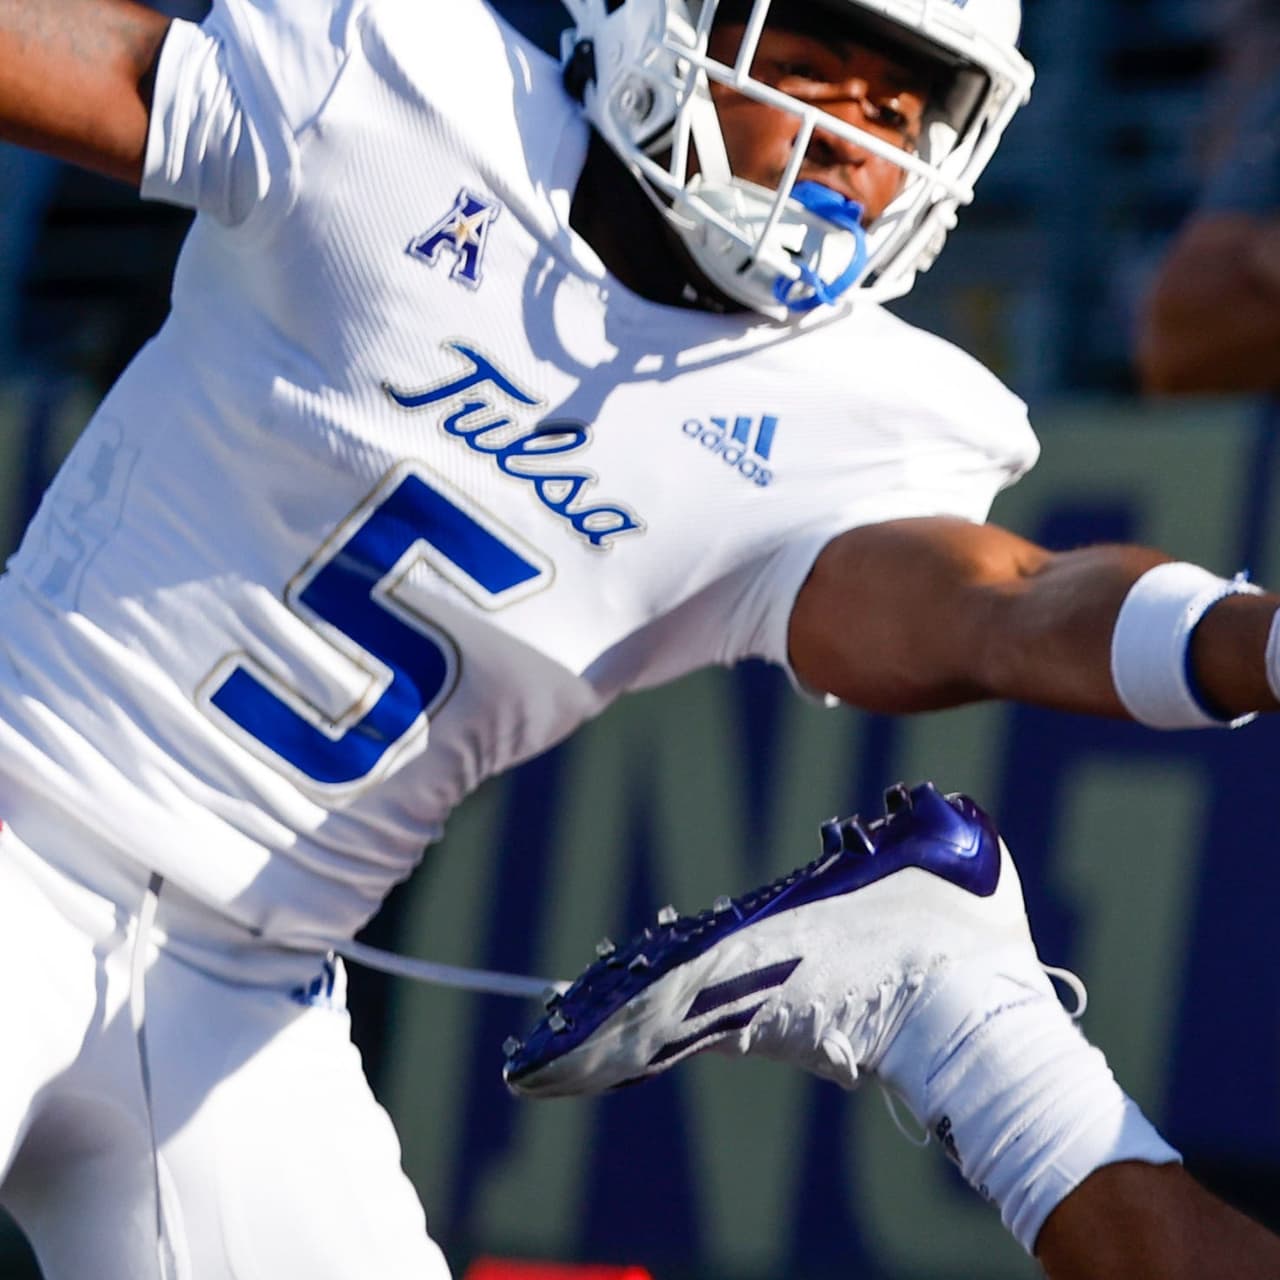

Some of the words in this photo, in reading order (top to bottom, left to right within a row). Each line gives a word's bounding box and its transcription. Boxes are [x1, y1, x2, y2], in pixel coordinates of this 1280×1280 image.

[381, 338, 646, 551] Tulsa
[682, 418, 773, 487] adidas
[200, 460, 553, 792] 5
